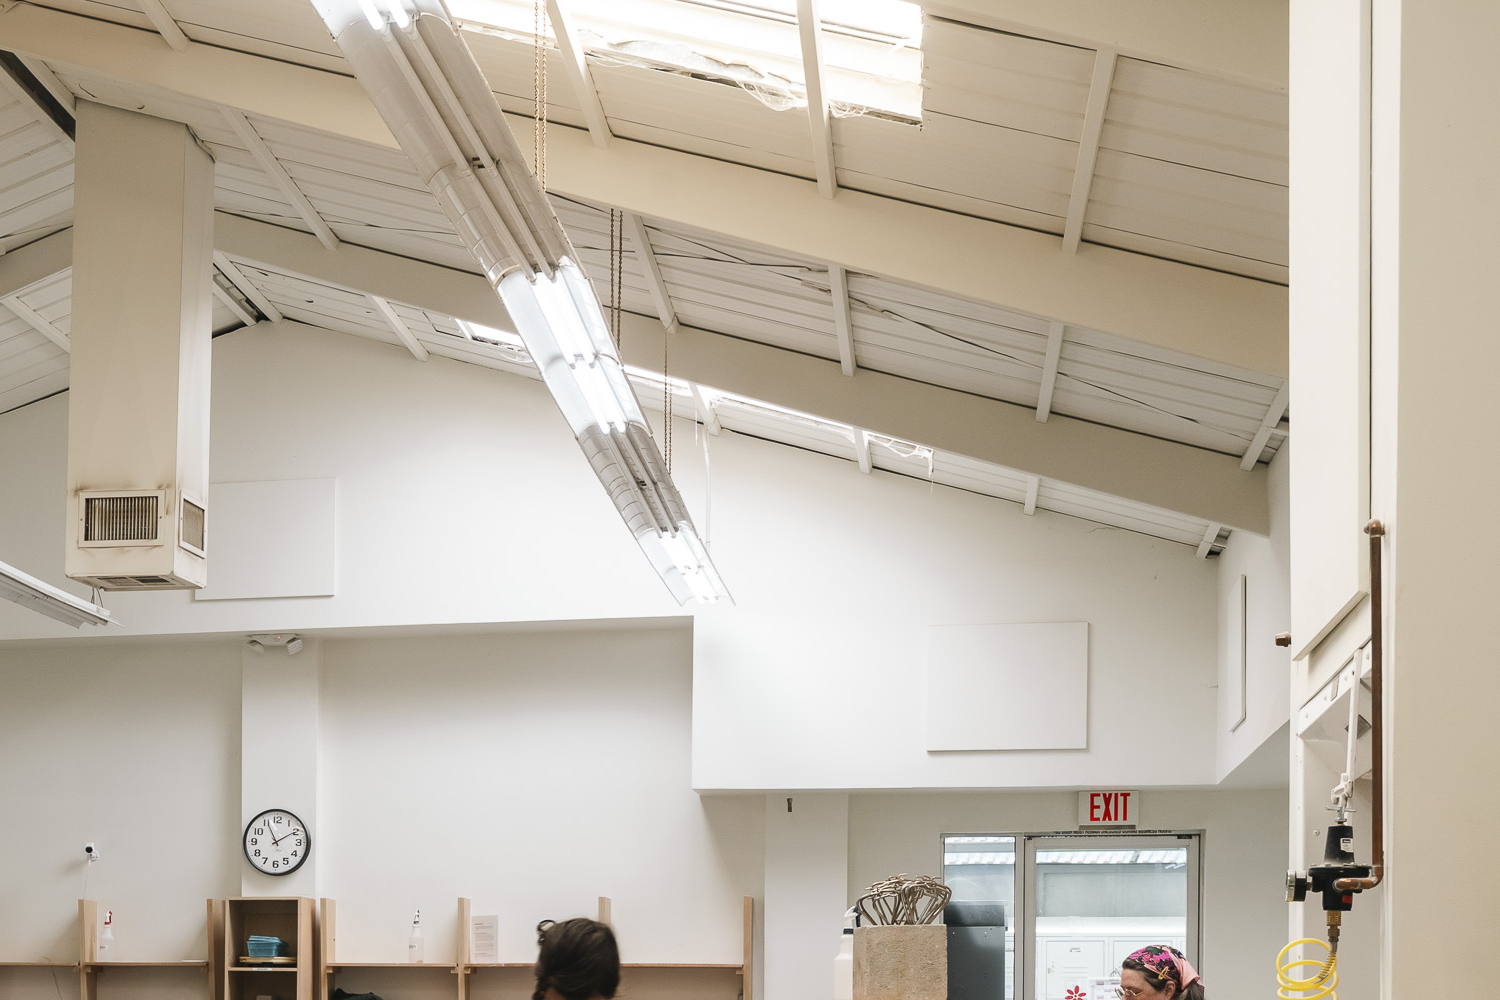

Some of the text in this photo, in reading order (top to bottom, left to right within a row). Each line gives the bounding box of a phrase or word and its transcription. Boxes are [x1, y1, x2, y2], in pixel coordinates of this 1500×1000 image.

[1089, 792, 1131, 821] EXIT
[263, 819, 270, 827] 11
[273, 816, 282, 824] 12
[287, 819, 291, 827] 1
[292, 828, 299, 836] 2
[254, 849, 261, 857] 8
[262, 857, 268, 865] 7
[272, 860, 279, 868] 6
[282, 857, 289, 865] 5
